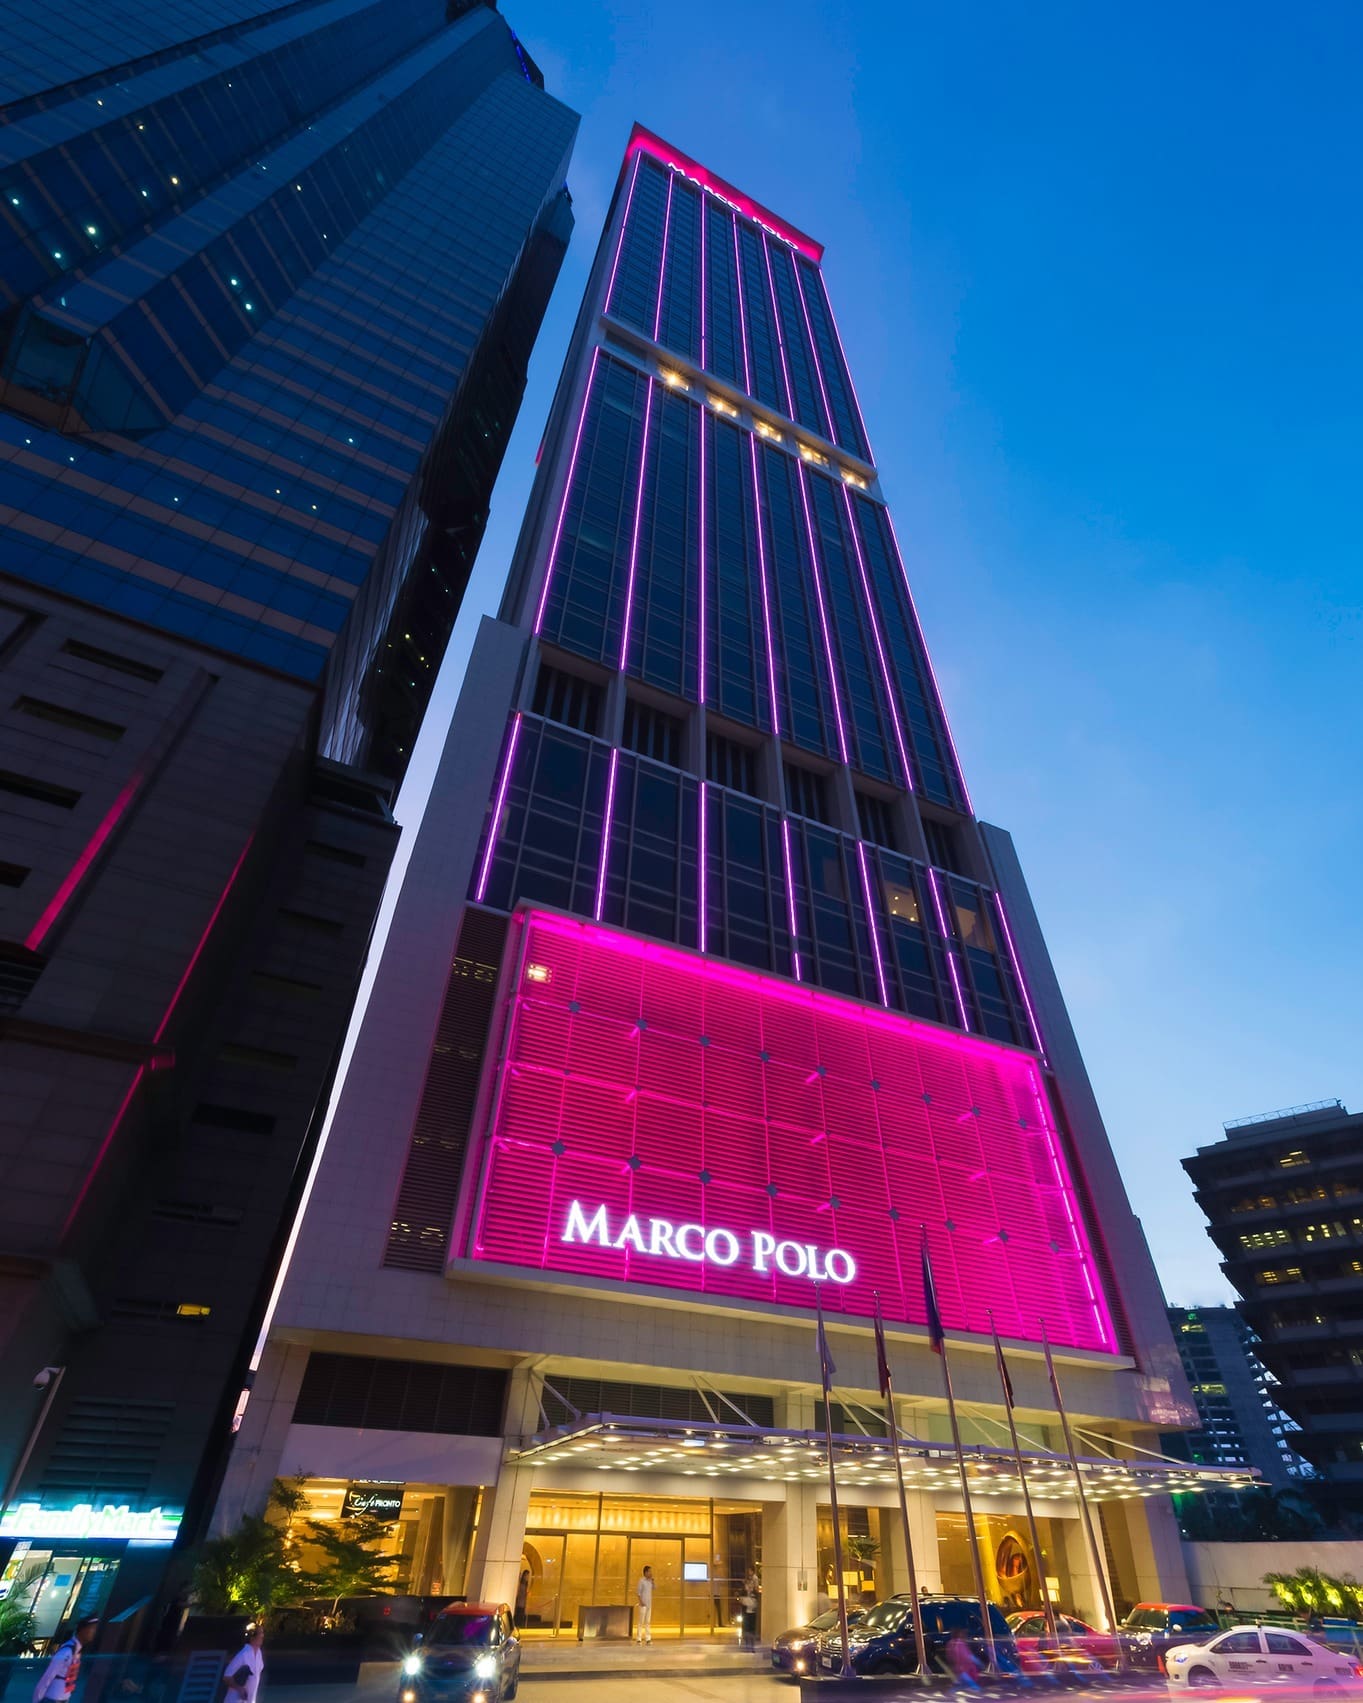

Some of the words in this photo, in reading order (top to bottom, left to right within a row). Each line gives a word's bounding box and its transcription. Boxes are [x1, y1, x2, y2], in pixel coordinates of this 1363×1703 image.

[561, 1199, 740, 1265] MARCO
[750, 1230, 856, 1283] POLO
[13, 1503, 162, 1538] FamilyMart
